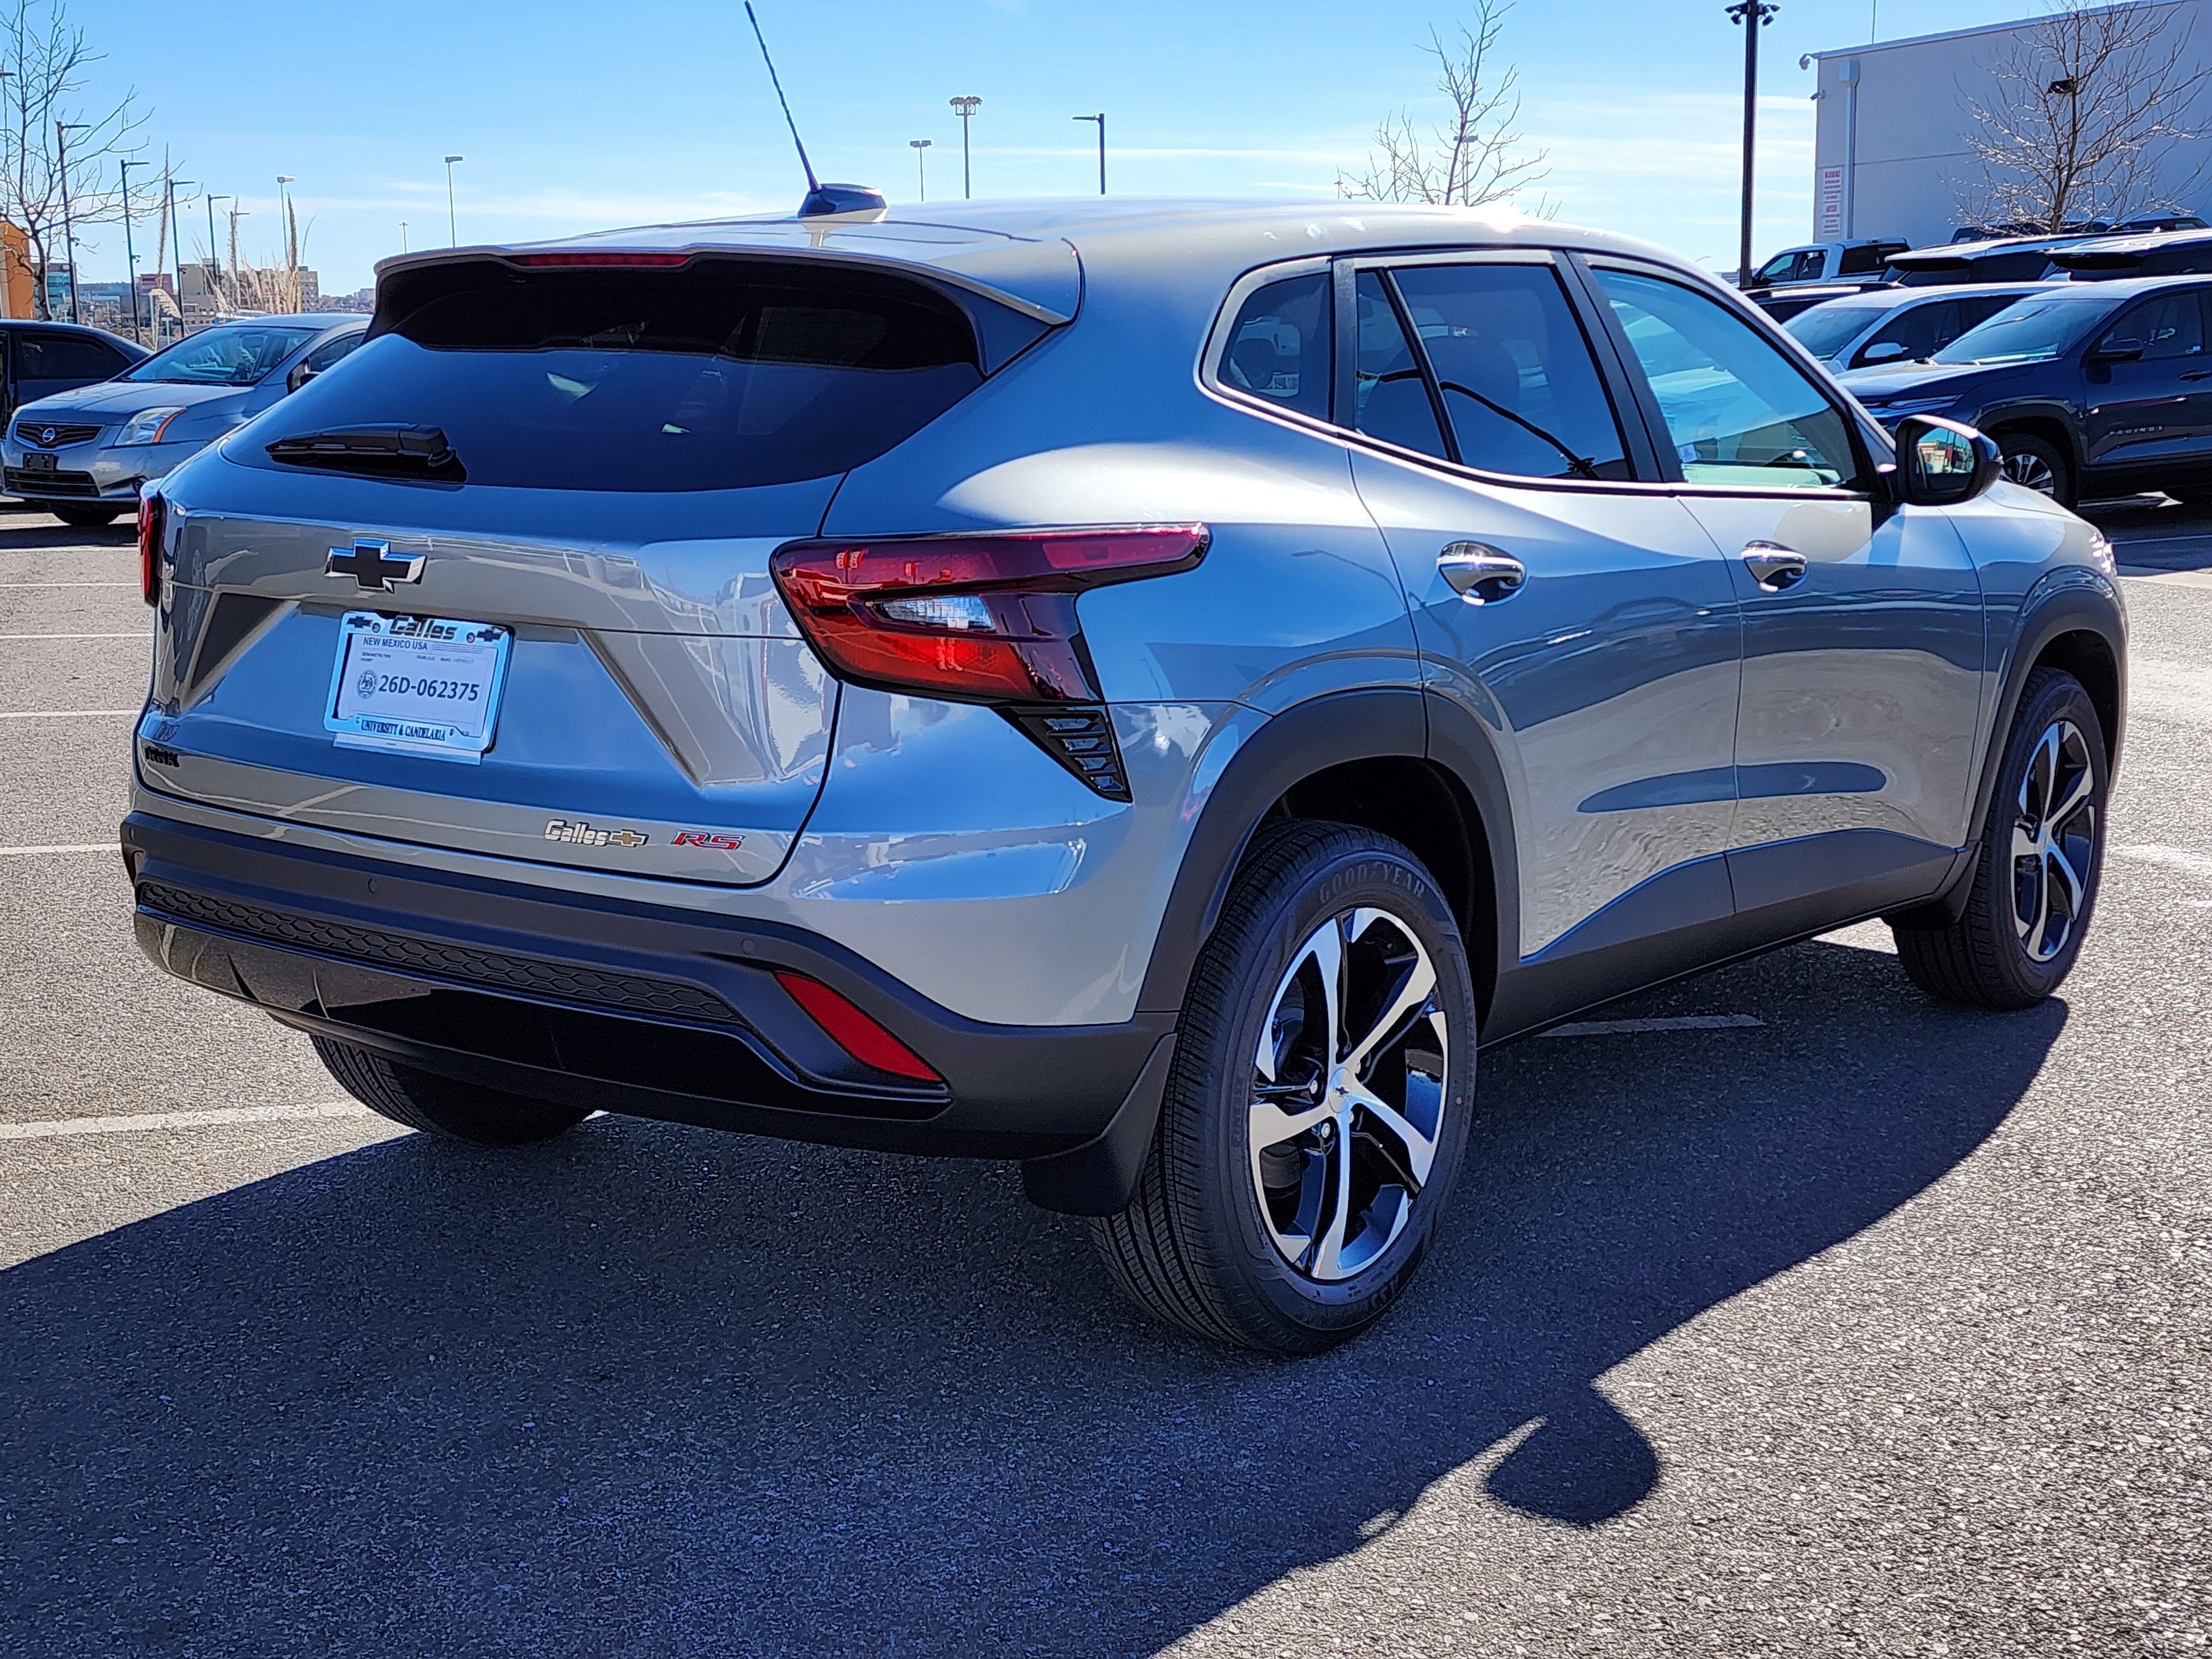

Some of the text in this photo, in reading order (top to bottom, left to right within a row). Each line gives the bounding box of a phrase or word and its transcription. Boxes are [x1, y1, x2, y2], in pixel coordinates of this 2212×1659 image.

[389, 615, 458, 640] Galles
[363, 637, 380, 646] NEW
[382, 638, 411, 649] MEXICO
[412, 641, 428, 650] USA
[378, 675, 480, 701] 26D-062375
[361, 719, 399, 735] UNIVERSITY
[405, 726, 446, 741] CANDELARIA
[545, 819, 610, 846] Galles
[671, 830, 746, 851] RS
